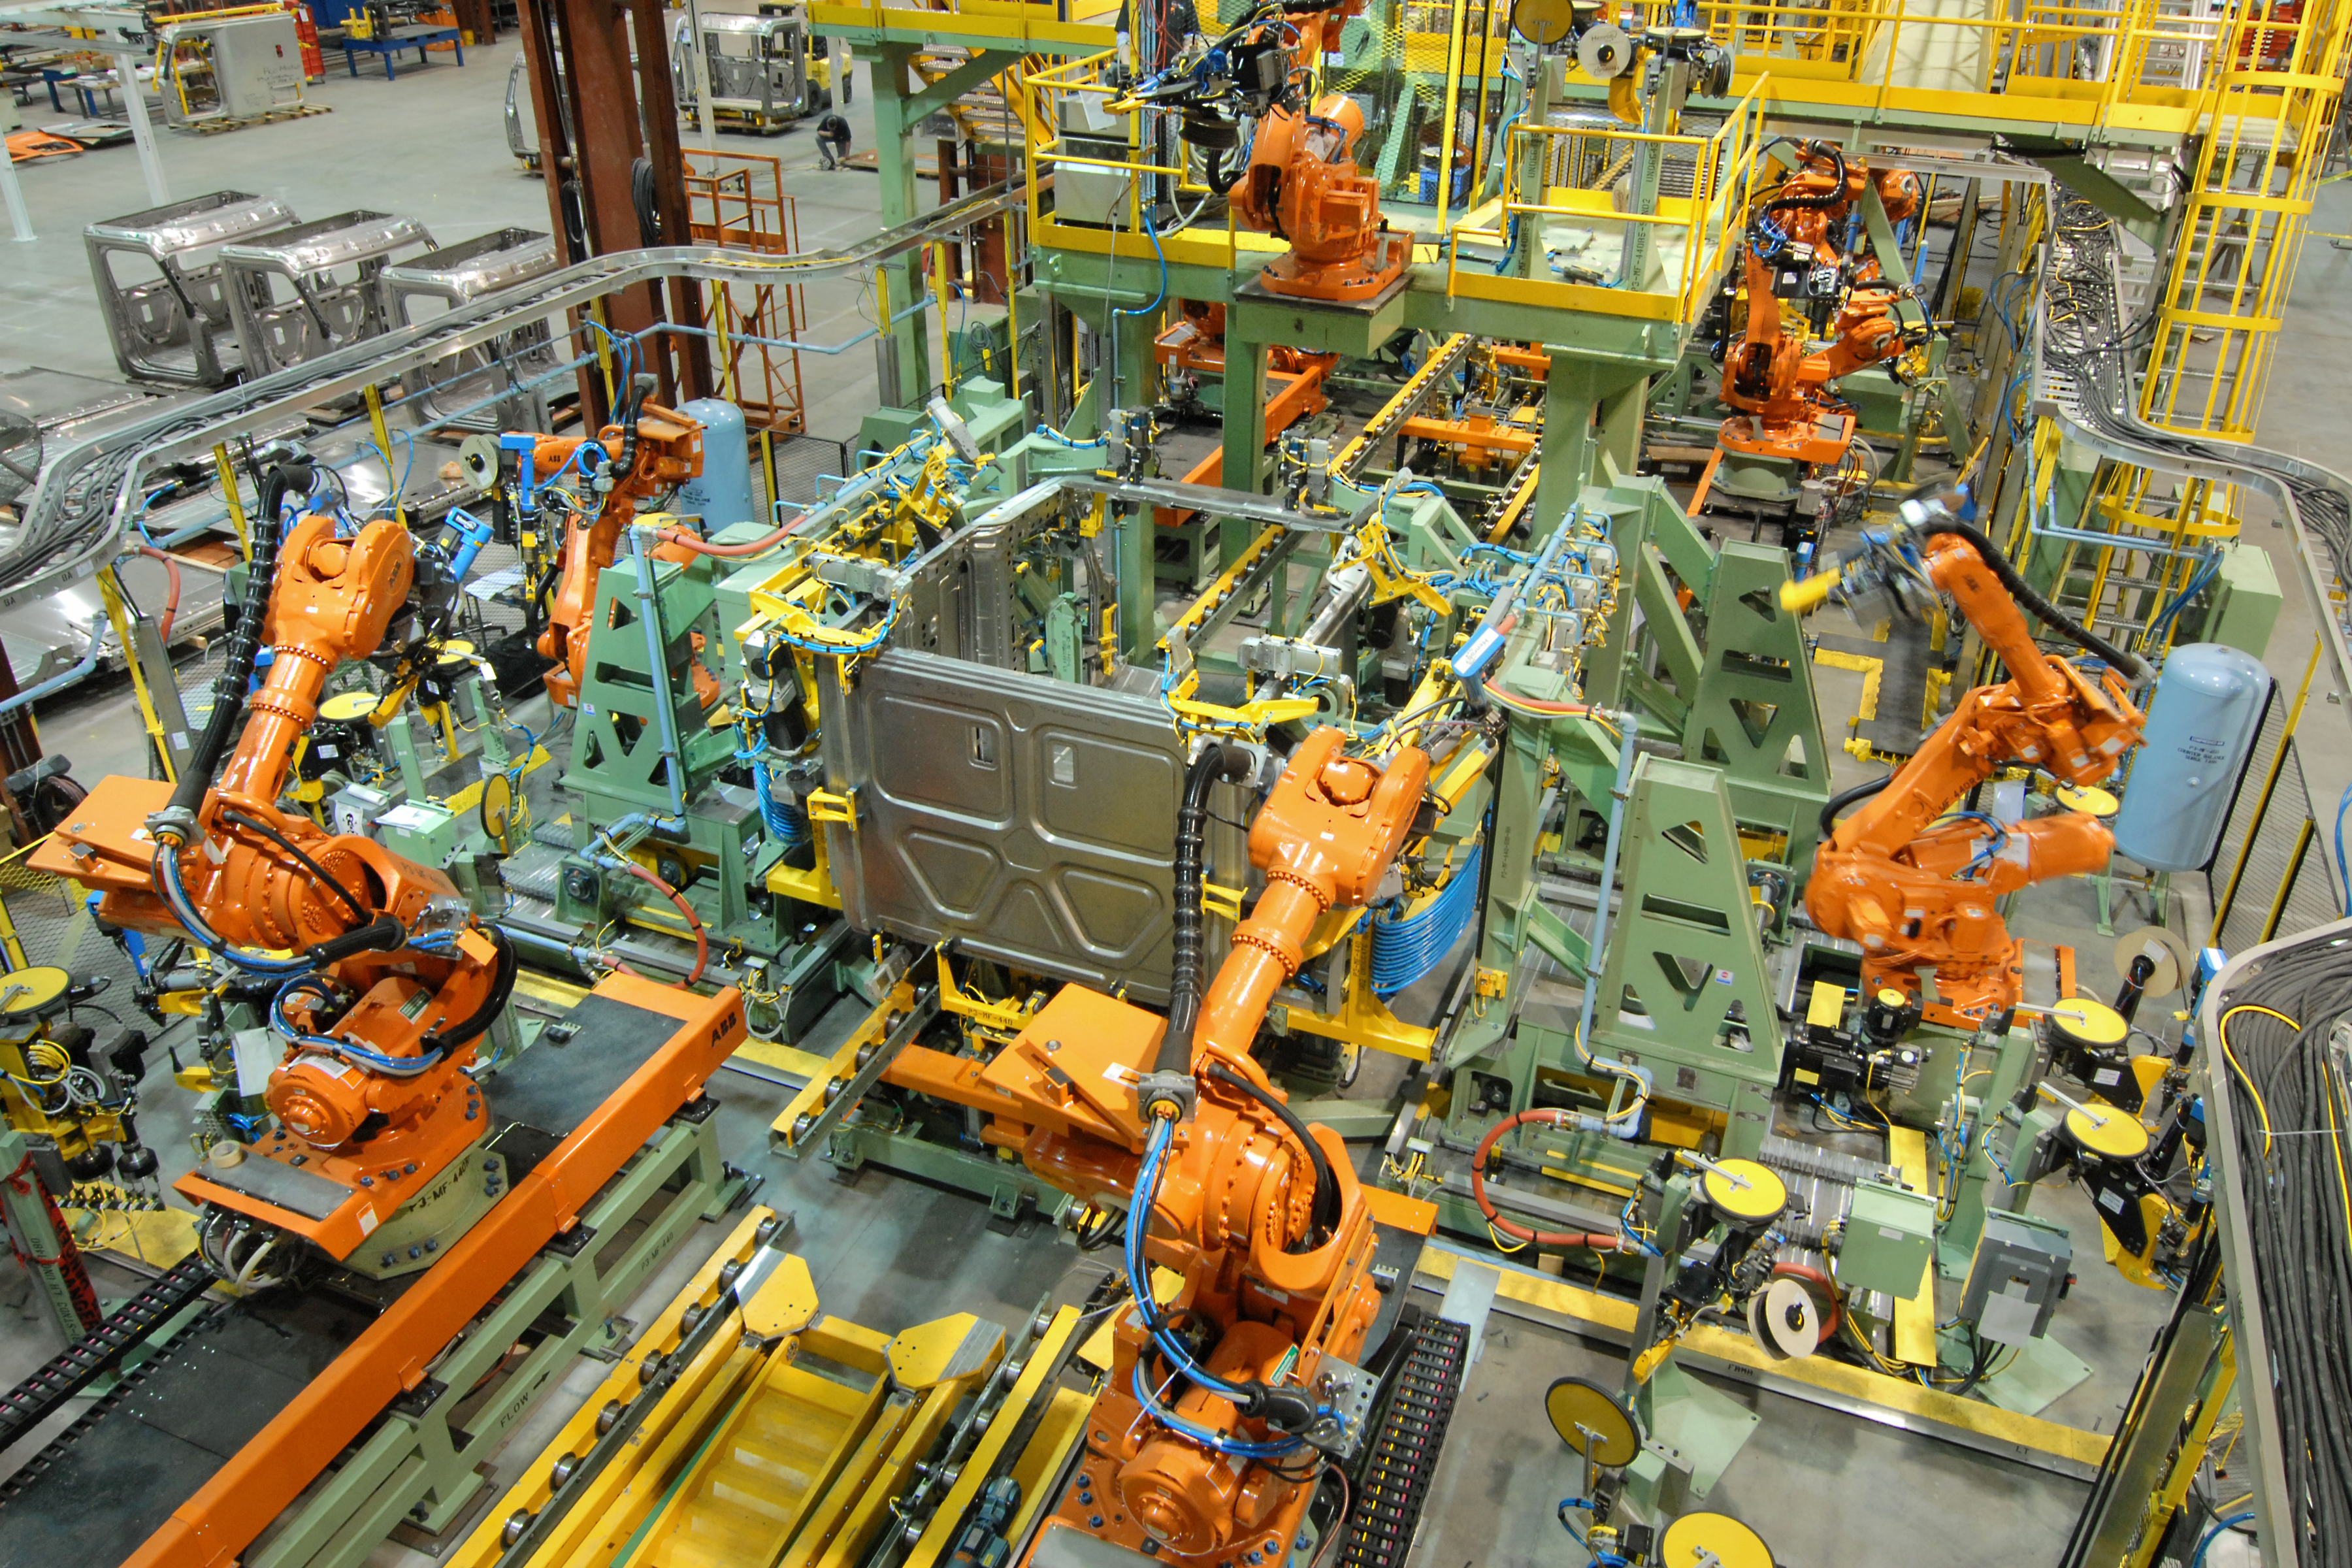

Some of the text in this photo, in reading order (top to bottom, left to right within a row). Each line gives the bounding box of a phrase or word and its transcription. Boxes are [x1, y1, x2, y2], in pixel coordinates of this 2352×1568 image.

[1646, 141, 1660, 183] UN06643
[548, 454, 562, 464] ABB
[711, 1011, 738, 1049] ABB
[968, 1007, 1013, 1026] P3-MF-440
[500, 1392, 529, 1429] FLOW
